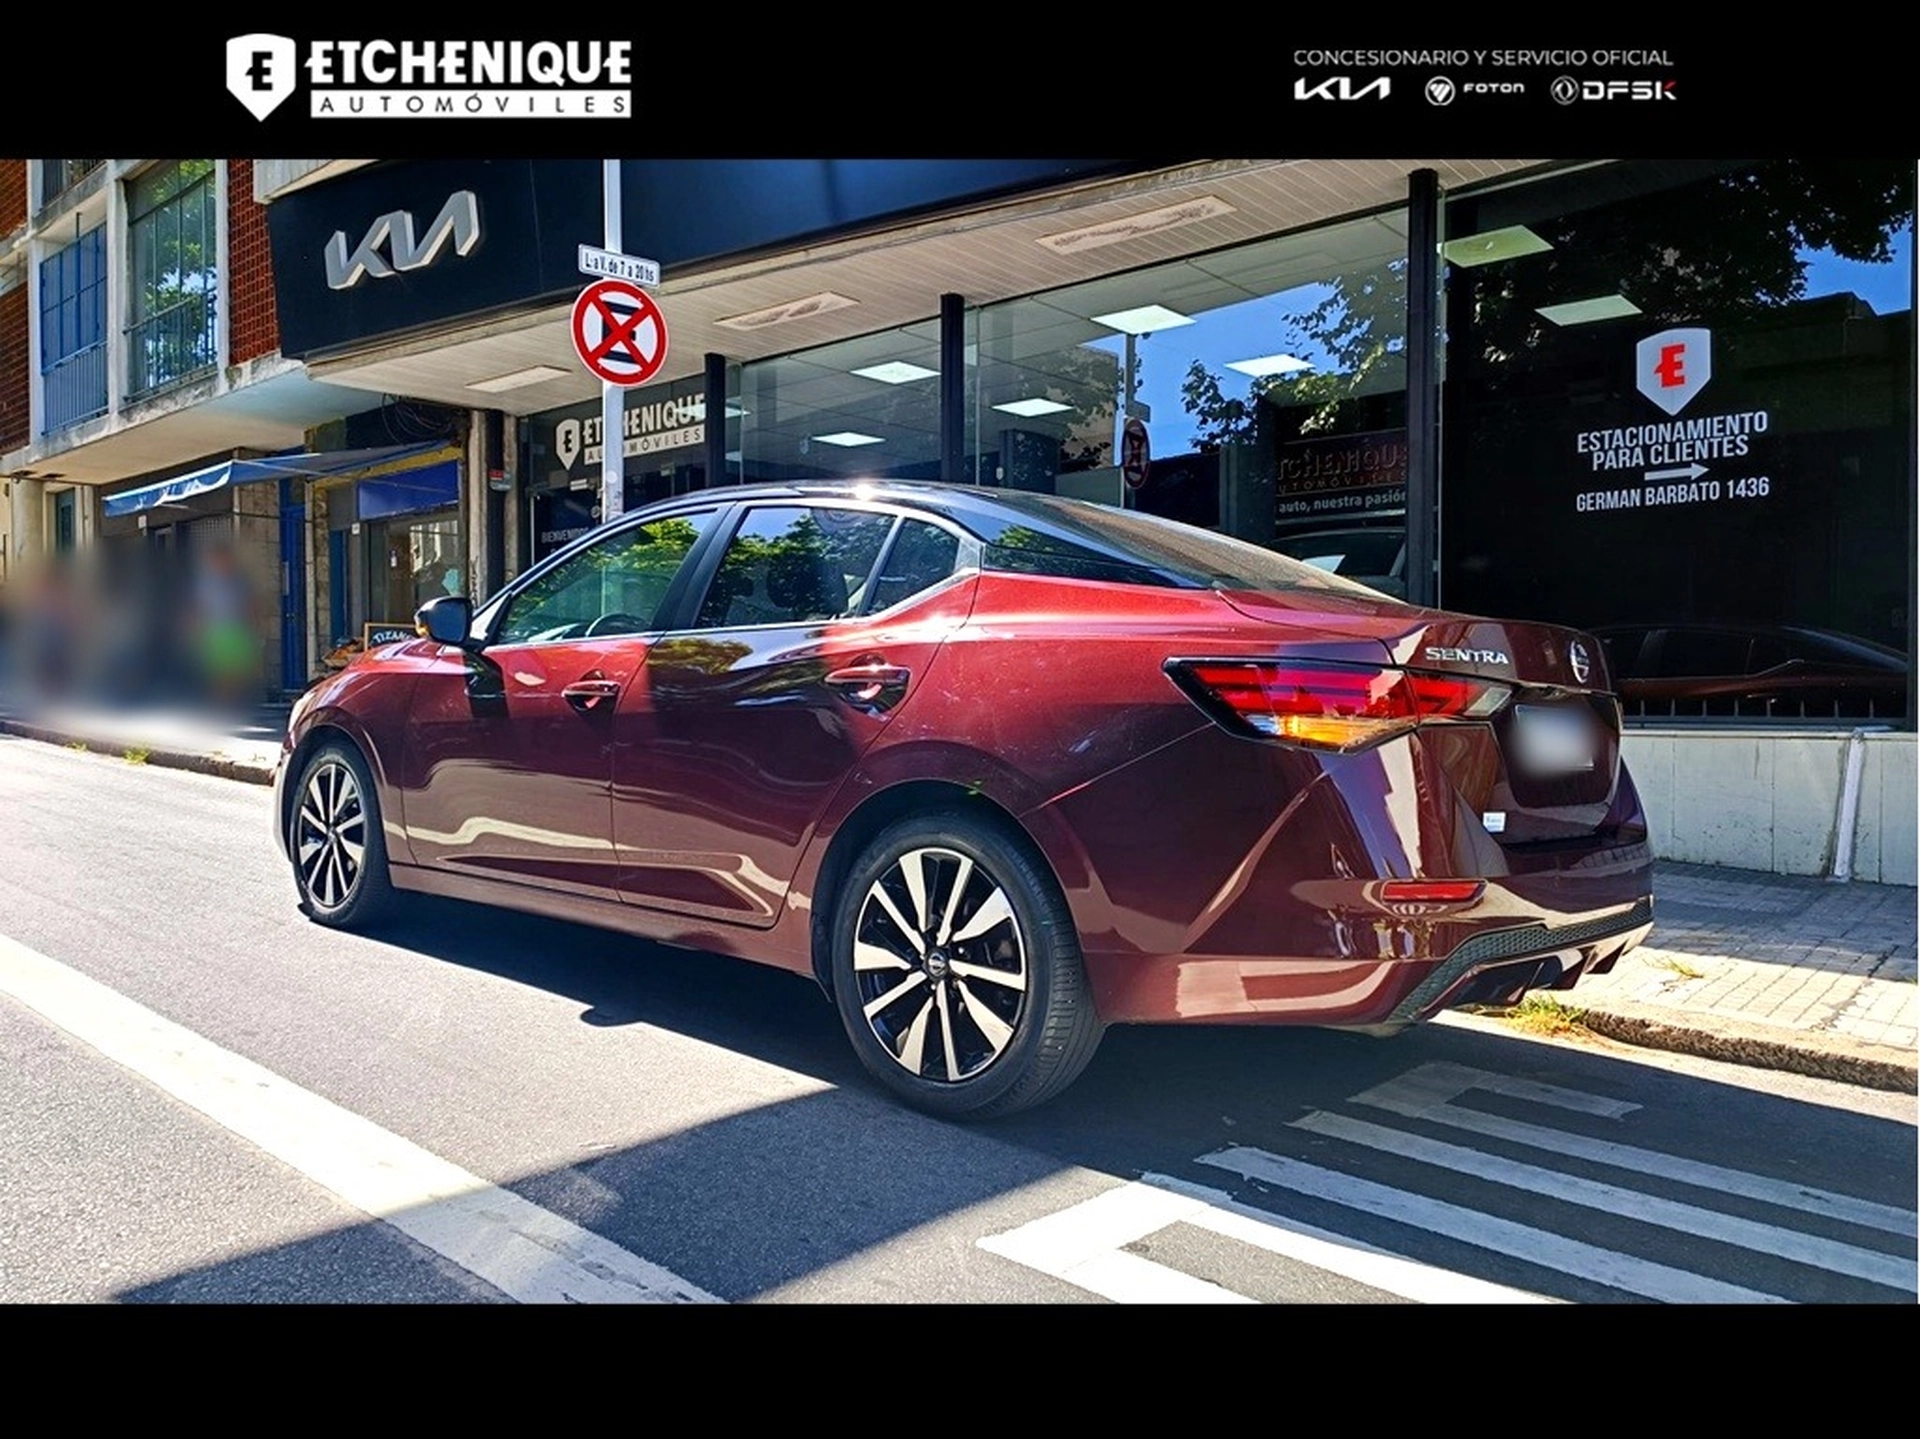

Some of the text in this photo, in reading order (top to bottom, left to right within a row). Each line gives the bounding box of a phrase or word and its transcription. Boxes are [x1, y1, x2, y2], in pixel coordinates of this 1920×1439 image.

[324, 189, 480, 290] KIA
[609, 258, 618, 274] de
[620, 260, 625, 275] 7
[1577, 410, 1768, 453] ESTACIONAMIENTO
[1592, 434, 1749, 471] PARA CLIENTES
[1279, 500, 1312, 514] auto,
[1313, 495, 1363, 511] nuestra
[1576, 476, 1770, 512] GERMAN BARBATO 1436
[1425, 646, 1509, 664] SENTRA
